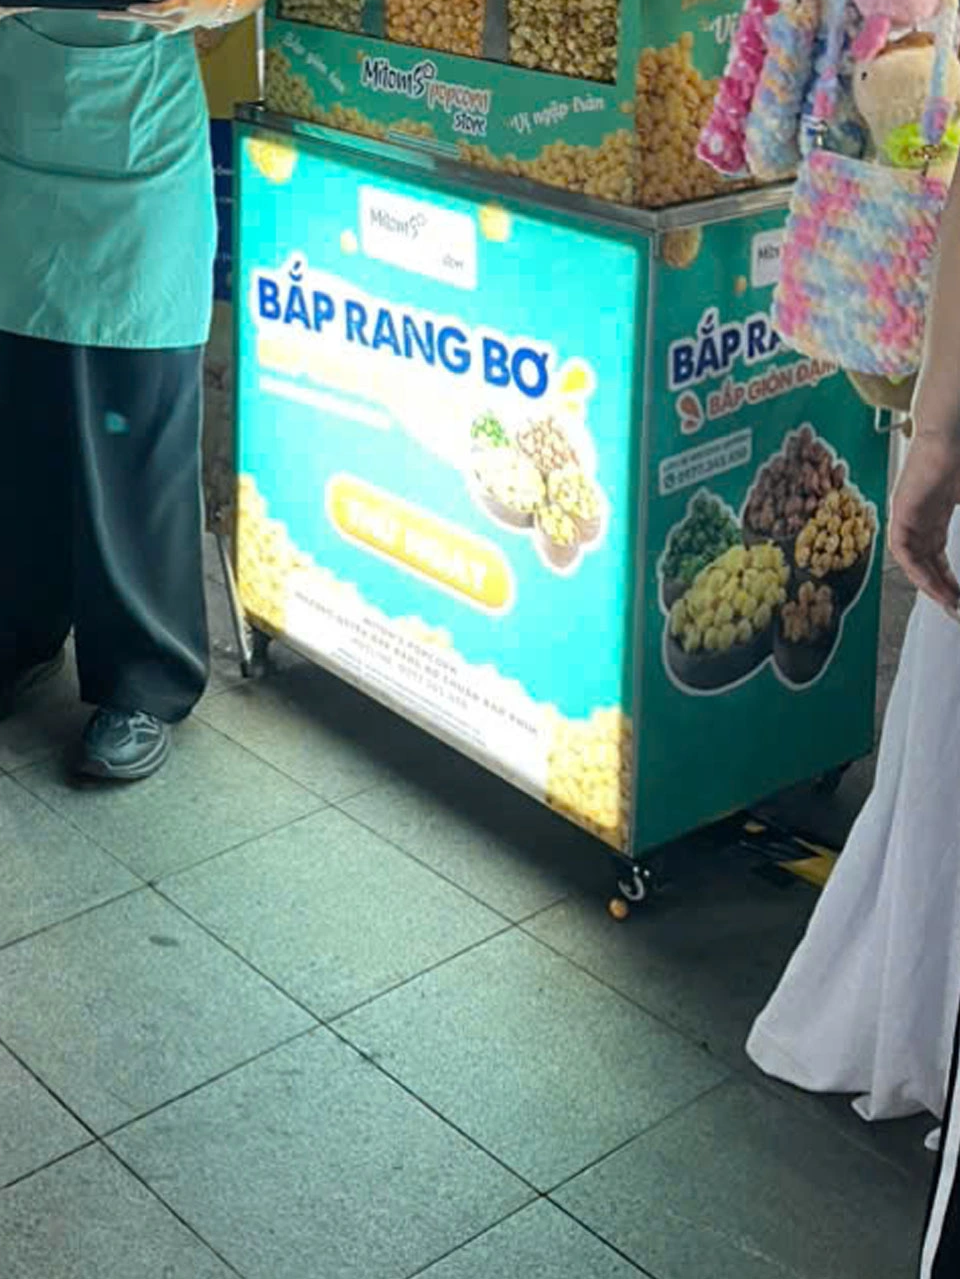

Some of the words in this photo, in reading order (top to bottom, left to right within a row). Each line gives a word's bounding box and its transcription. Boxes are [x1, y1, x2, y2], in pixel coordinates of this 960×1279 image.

[258, 261, 335, 332] BẮP
[345, 299, 471, 374] RANG
[482, 337, 548, 398] BƠ
[673, 314, 740, 385] BẮP
